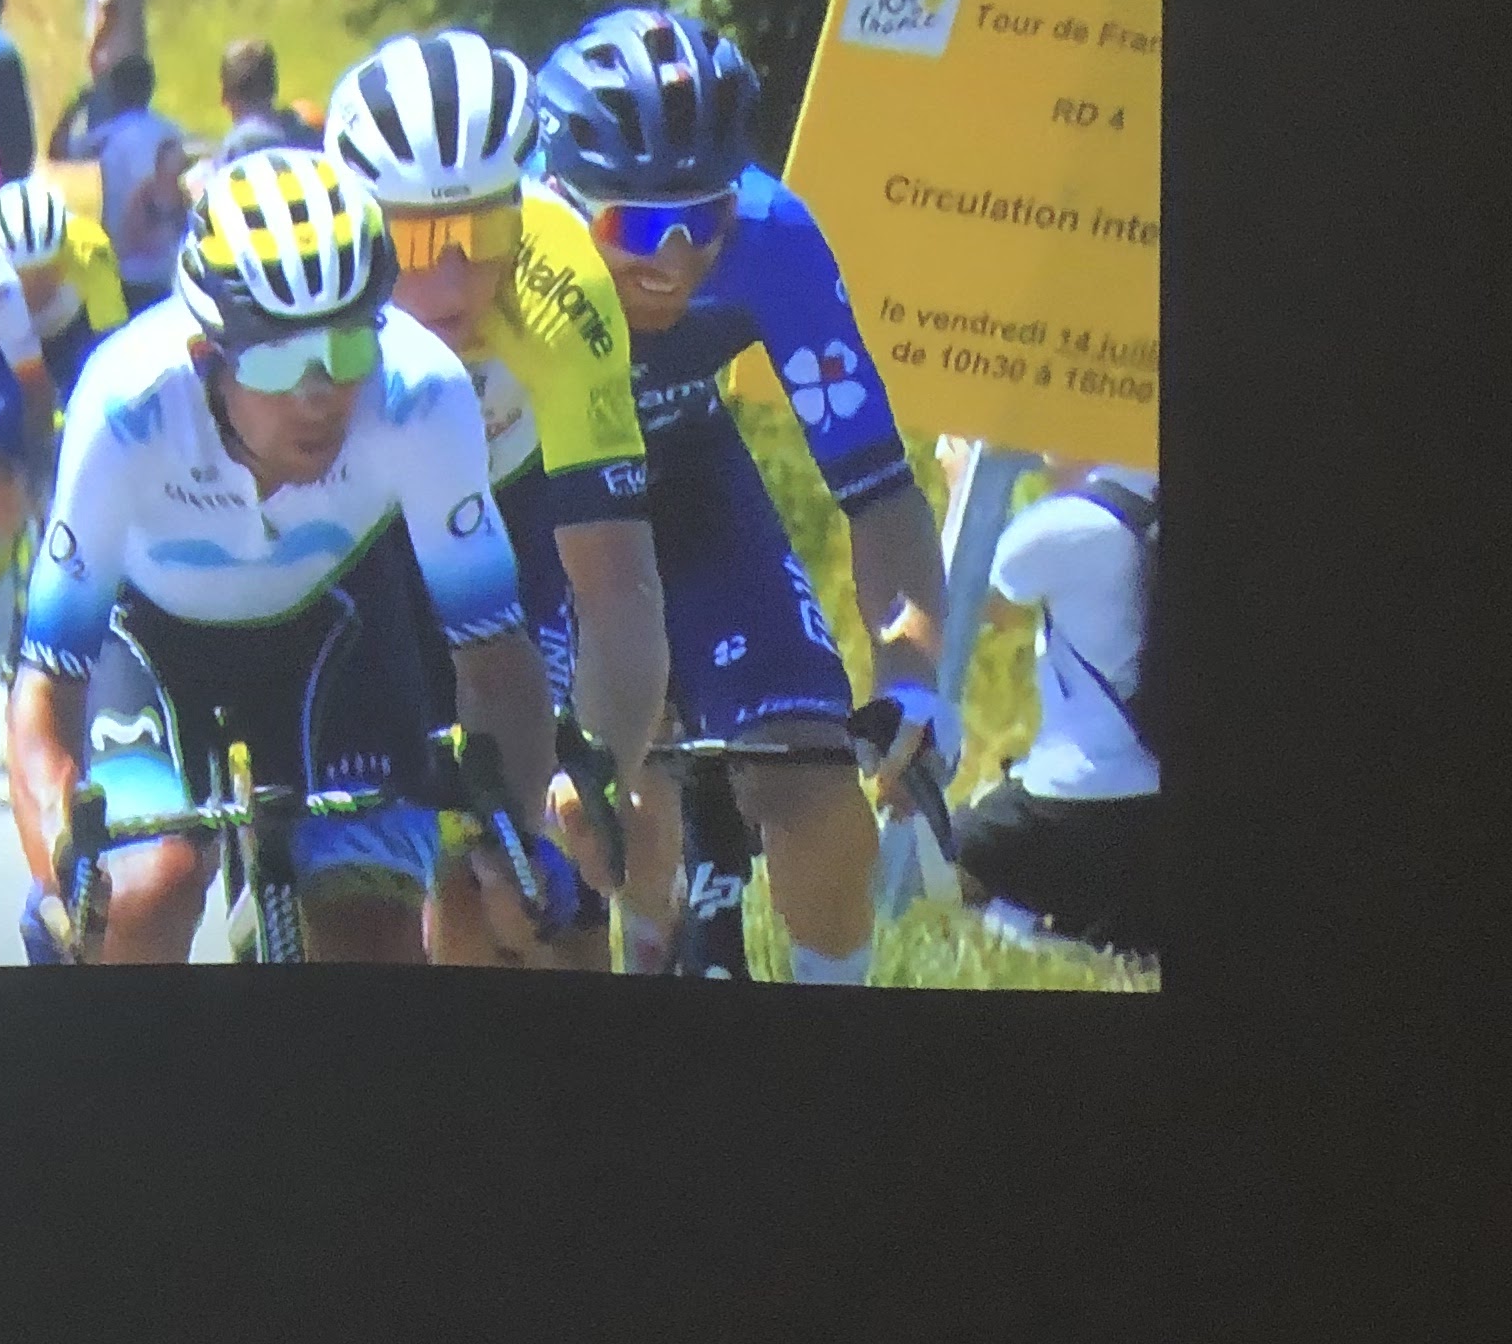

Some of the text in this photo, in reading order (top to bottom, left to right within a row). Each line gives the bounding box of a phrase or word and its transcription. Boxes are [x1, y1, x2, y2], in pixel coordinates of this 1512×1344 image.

[977, 2, 1044, 37] Tour
[1053, 16, 1090, 46] de
[1052, 97, 1100, 128] RD
[884, 174, 1080, 233] Circulation
[880, 295, 907, 325] le
[916, 308, 1049, 346] vendredi
[891, 340, 928, 367] de
[941, 345, 1028, 384] 10h30
